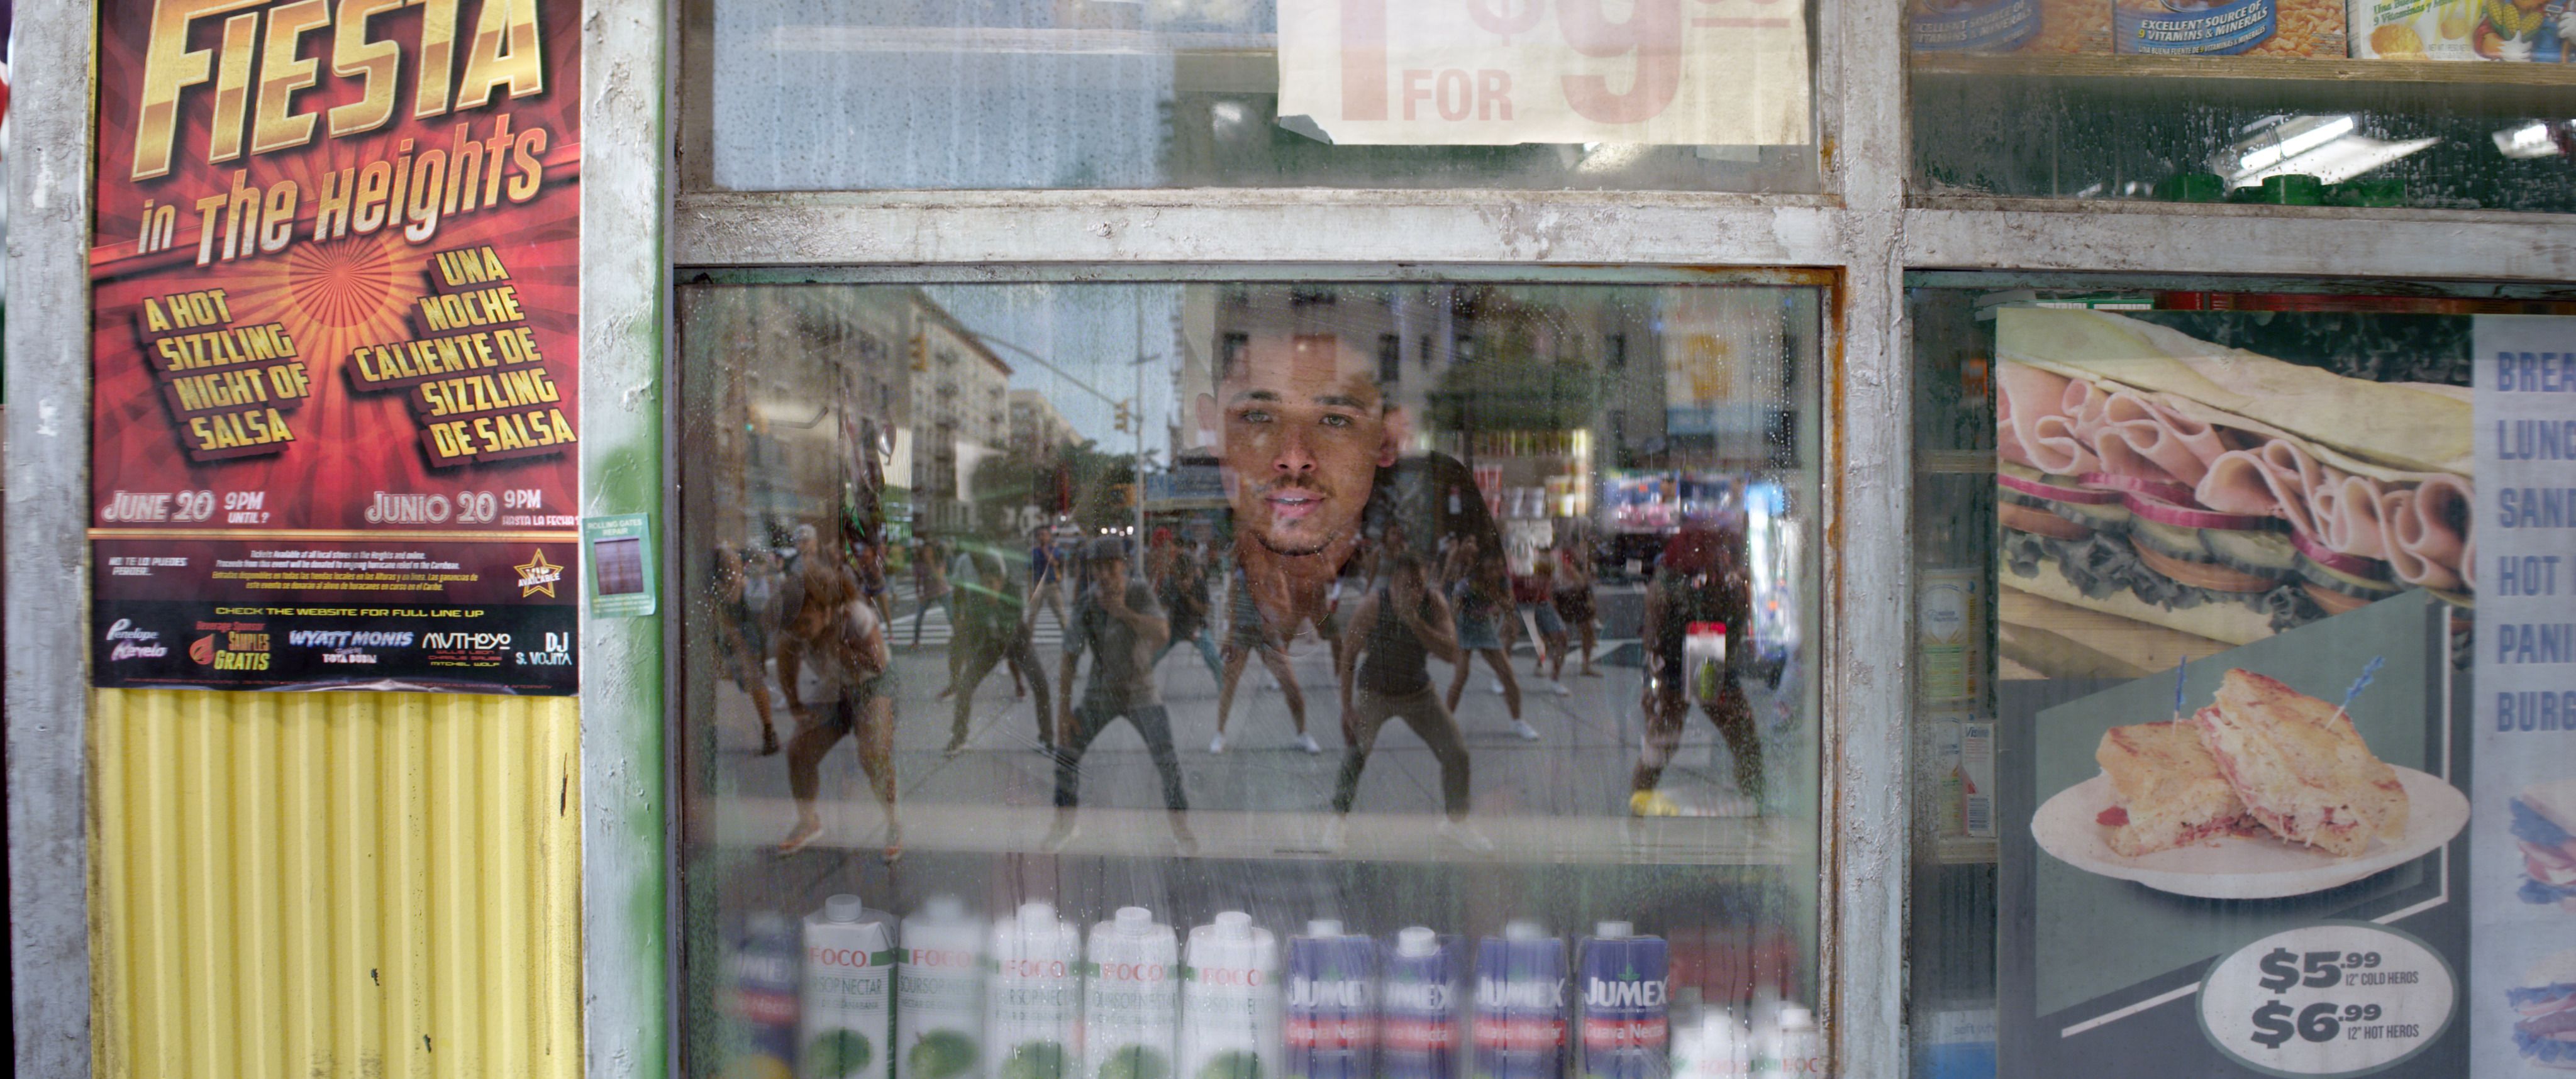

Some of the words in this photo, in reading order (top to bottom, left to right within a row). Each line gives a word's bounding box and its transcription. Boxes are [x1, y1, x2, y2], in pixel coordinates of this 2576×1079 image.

[2138, 29, 2146, 38] 9
[2148, 30, 2202, 42] VITAMINS
[2205, 29, 2214, 38] &
[2215, 6, 2268, 37] MINERALS
[2141, 19, 2204, 31] EXCELLENT
[2204, 7, 2247, 27] SOURCE
[2248, 0, 2263, 14] OF
[2170, 47, 2192, 55] FUENTE
[130, 0, 544, 182] FIESTA
[1402, 69, 1514, 123] FOR
[138, 199, 176, 255] in
[195, 169, 298, 268] The
[312, 113, 548, 246] Heights
[435, 246, 510, 287] UNA
[143, 297, 172, 333] A
[165, 289, 234, 329] HOT
[419, 287, 525, 333] NOCHE
[157, 322, 299, 372] SIZZLING
[353, 332, 498, 384] CALIENTE
[494, 326, 542, 366] DE
[173, 368, 270, 412] NIGHT
[269, 363, 310, 401] OF
[421, 368, 561, 418] SIZZLING
[189, 408, 296, 451] SALSA
[430, 421, 478, 460] DE
[475, 408, 577, 453] SALSA
[101, 490, 171, 523] JUNE
[170, 489, 216, 523] 20
[225, 490, 265, 511] 9PM
[365, 490, 452, 524] JUNIO
[456, 490, 497, 524] 20
[504, 489, 541, 509] 9PM
[228, 512, 260, 524] UNTIL
[502, 516, 531, 526] HASTA
[533, 516, 545, 526] LA
[547, 516, 575, 526] FECHA
[587, 521, 618, 529] ROLLING
[619, 519, 643, 528] GATES
[152, 556, 189, 567] PUEDES
[518, 573, 561, 587] AVAILABLE
[2498, 555, 2562, 597] HOT
[216, 607, 264, 616] CHECK
[296, 608, 357, 616] WEBSITE
[465, 610, 484, 618] UP
[106, 618, 160, 641] Penelope
[289, 630, 352, 648] WYATT
[350, 631, 415, 647] MONIS
[228, 631, 270, 651] SAMPLES
[545, 632, 569, 653] DJ
[214, 650, 270, 670] GRATIS
[516, 652, 527, 665] S.
[529, 652, 572, 665] VOJITA
[809, 946, 867, 968] FOCO
[913, 948, 971, 966] FOCO
[1004, 959, 1066, 978] FOCO
[1102, 962, 1164, 982] FOCO
[1201, 967, 1263, 987] FOCO
[2345, 972, 2358, 986] 12"
[2360, 972, 2386, 985] COLD
[2387, 971, 2419, 985] HEROS
[841, 978, 882, 995] NECTAR
[1473, 976, 1566, 1008] JUMEX
[1585, 975, 1668, 1008] JUMEX
[1586, 1024, 1624, 1040] Guava
[2347, 1027, 2362, 1041] 12"
[2363, 1026, 2384, 1040] HOT
[2386, 1024, 2419, 1039] HEROS
